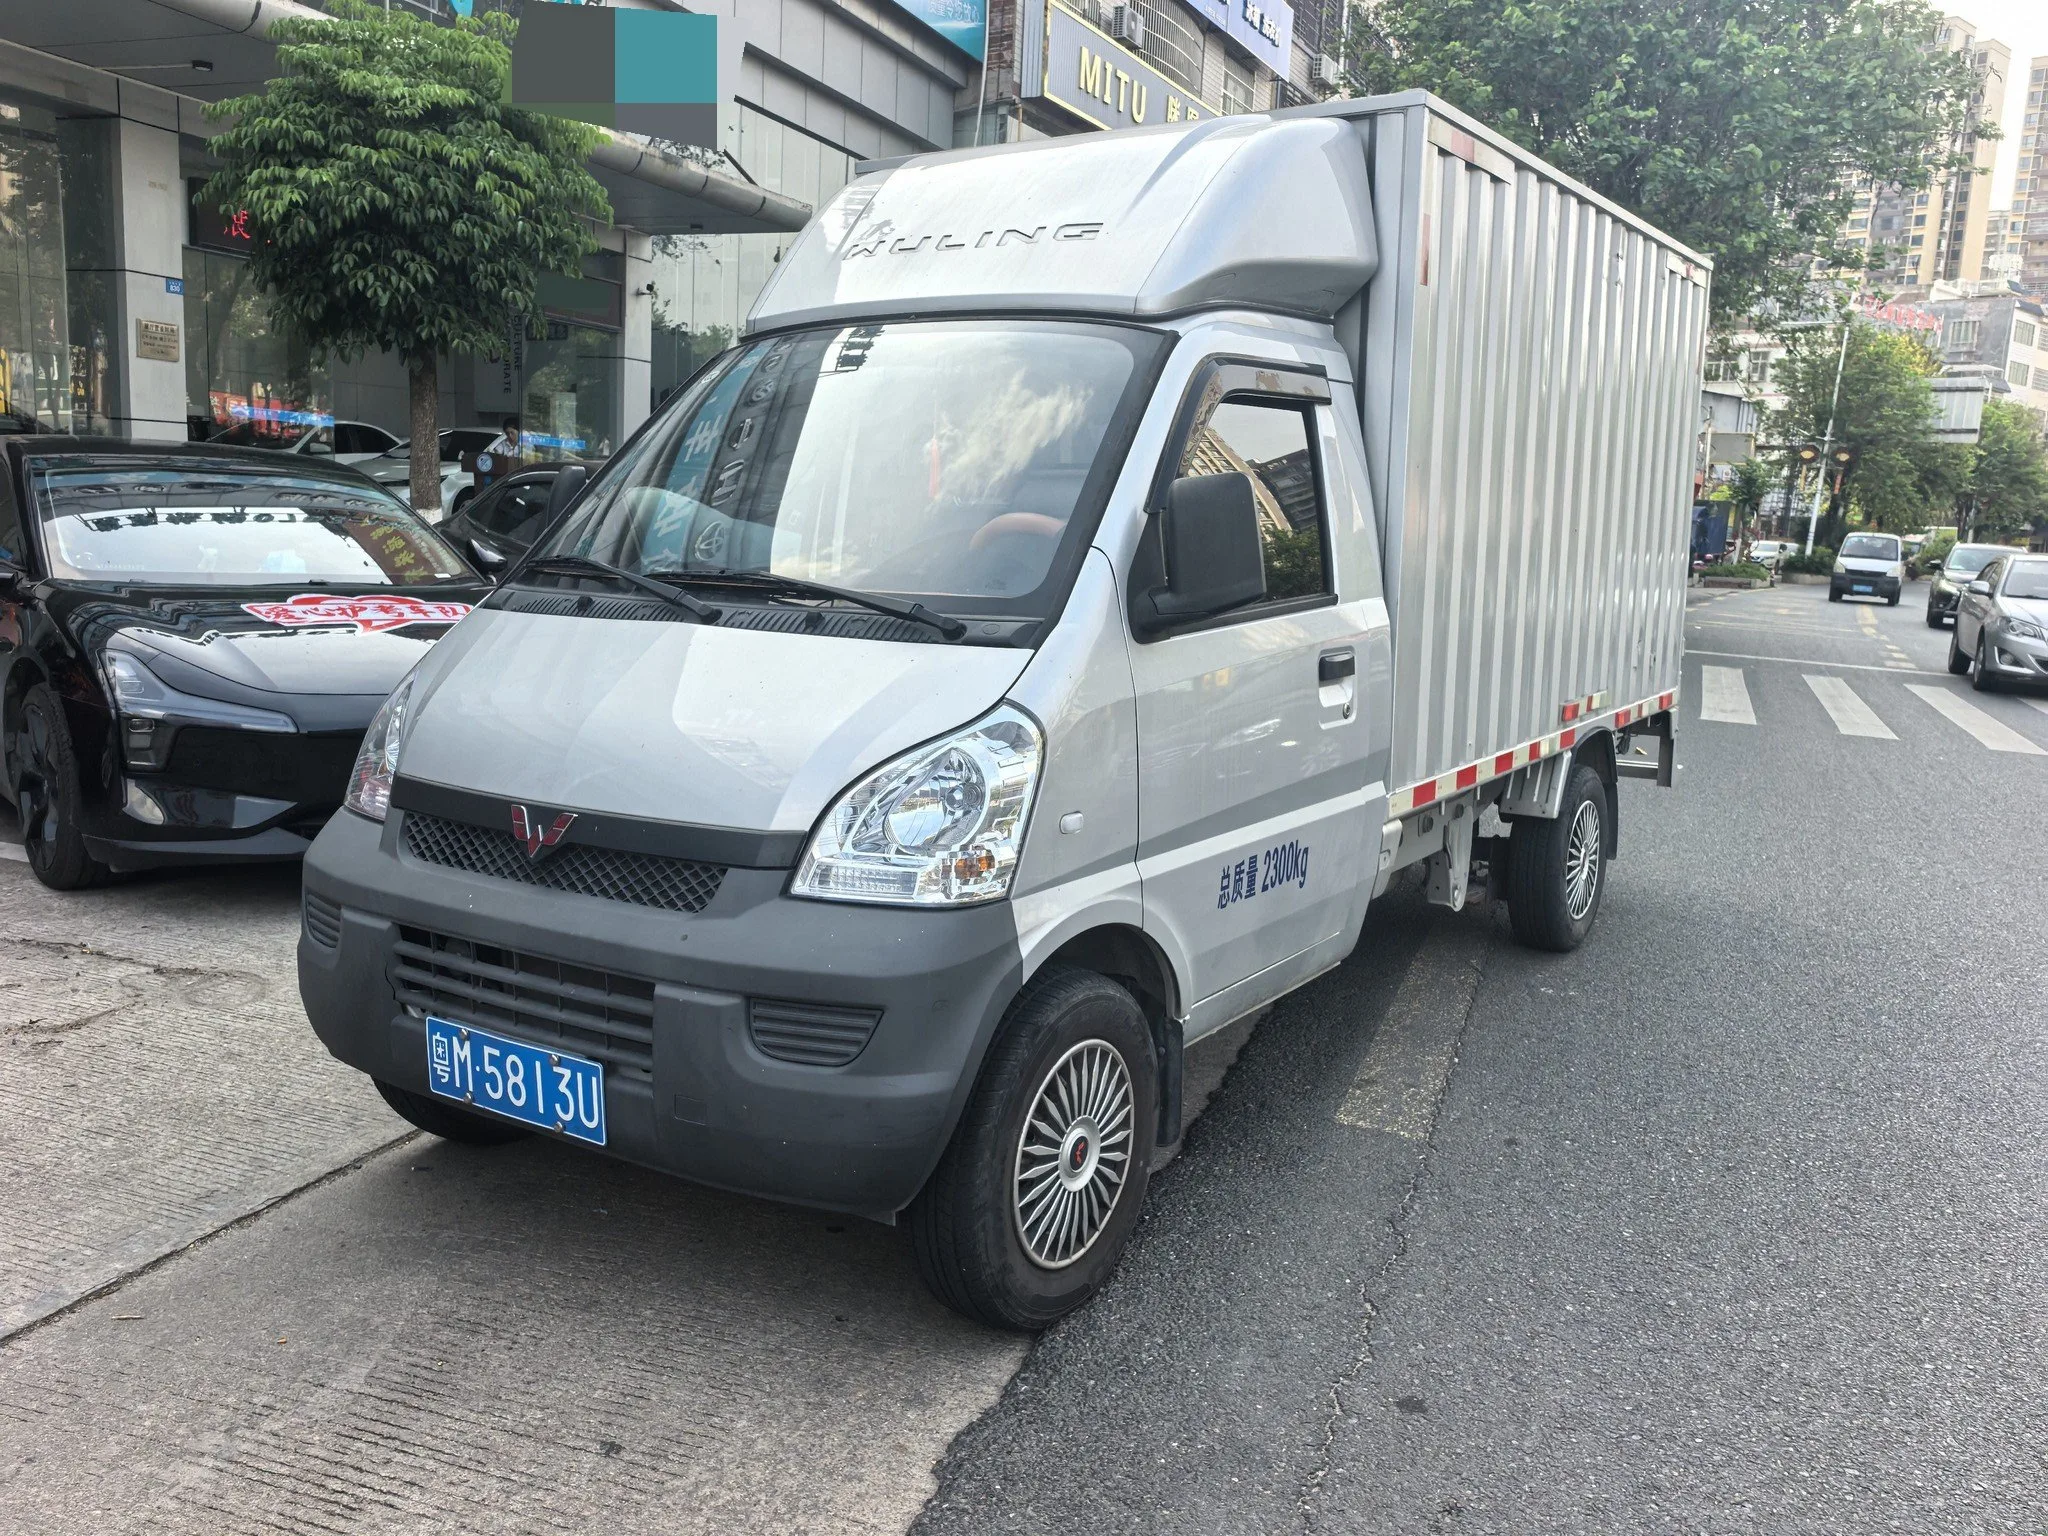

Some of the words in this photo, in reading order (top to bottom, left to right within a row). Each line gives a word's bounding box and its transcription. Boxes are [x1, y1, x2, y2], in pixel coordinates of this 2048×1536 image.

[1079, 46, 1147, 123] MITU
[841, 223, 1103, 260] WULING
[265, 605, 467, 620] 爱心护考车队
[1217, 854, 1259, 910] 总质量
[1261, 840, 1309, 893] 2300kg
